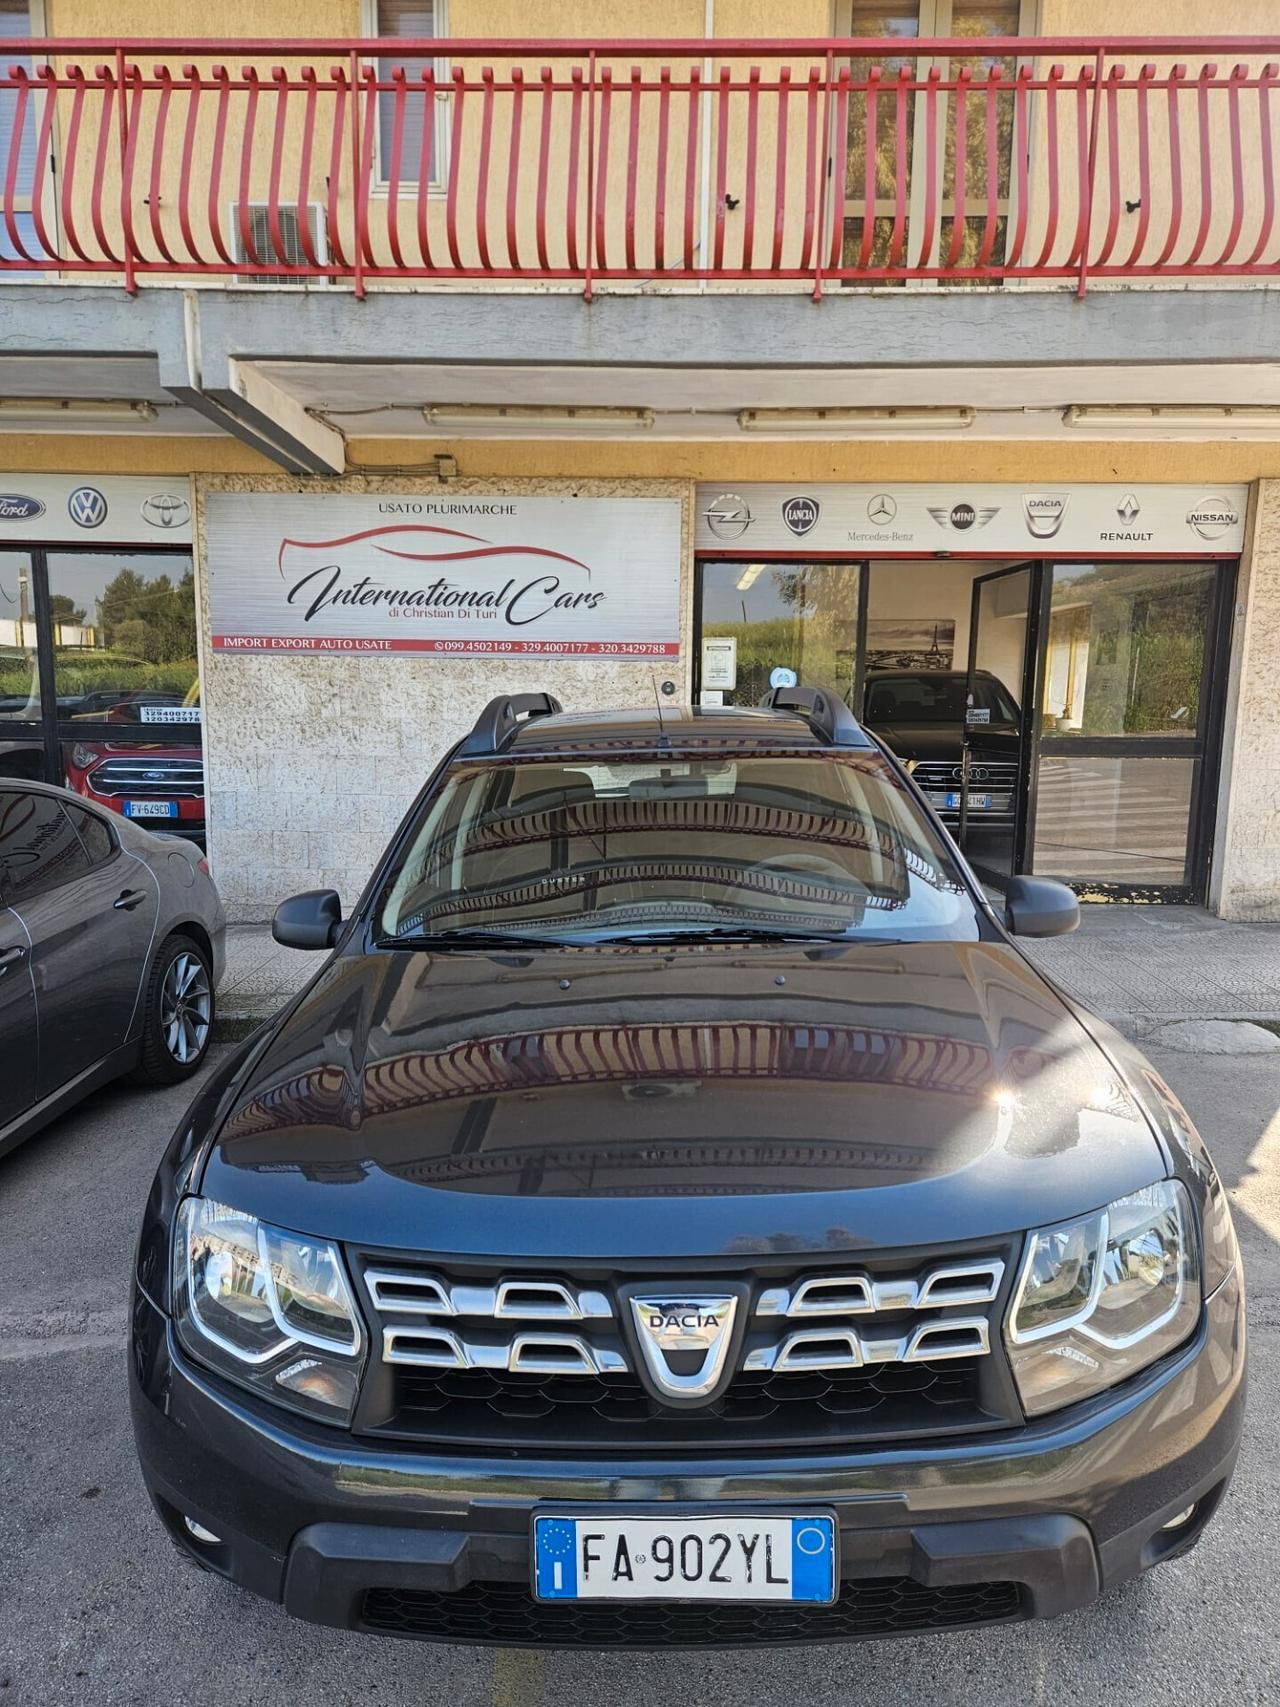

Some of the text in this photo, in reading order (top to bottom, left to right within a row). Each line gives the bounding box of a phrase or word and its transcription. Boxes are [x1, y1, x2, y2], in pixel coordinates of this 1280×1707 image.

[378, 502, 518, 515] USATO PLURIMARCHE
[1029, 499, 1062, 507] DACIA
[788, 509, 813, 521] LANCIA
[951, 511, 975, 522] MINI
[1190, 513, 1234, 522] NISSAN
[848, 531, 914, 542] Mercedes-Benz
[1100, 532, 1153, 541] RENAULT
[287, 565, 607, 625] International Cars
[388, 607, 497, 619] di Christian Di Turi
[223, 637, 392, 650] IMPORT EXPORT AUTO USATE
[444, 641, 666, 654] 099.4502149 329.4007177 320.3429788
[650, 1314, 719, 1328] DACIA
[582, 1533, 634, 1583] FA
[651, 1533, 789, 1584] 902YL
